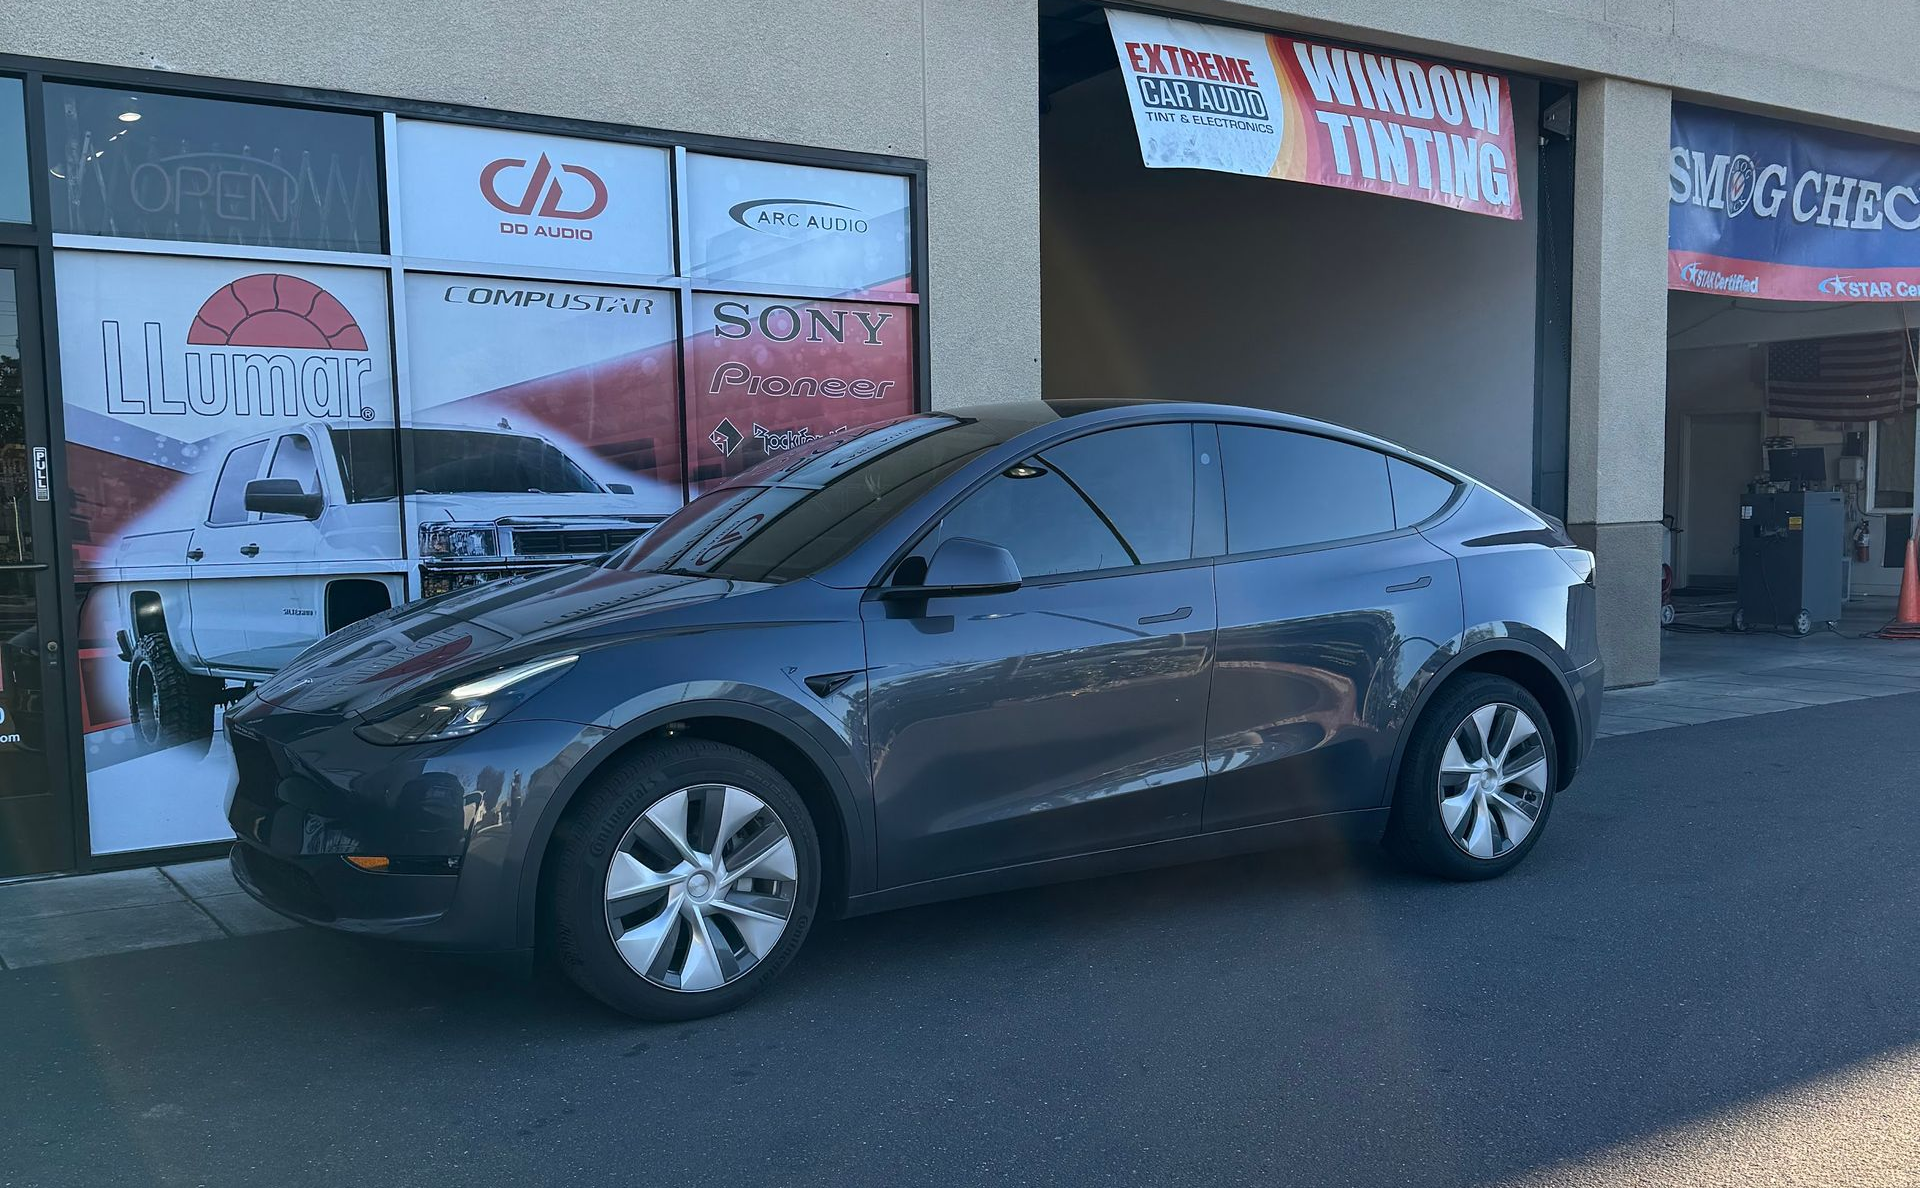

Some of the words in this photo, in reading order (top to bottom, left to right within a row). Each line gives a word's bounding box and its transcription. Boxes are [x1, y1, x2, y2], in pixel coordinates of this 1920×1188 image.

[1124, 42, 1258, 88] EXTREME
[1140, 77, 1195, 109] CAR
[1199, 83, 1267, 119] AUDIO
[1293, 42, 1500, 135] WINDOW
[1145, 111, 1177, 124] TINT
[1180, 116, 1190, 125] &
[1193, 117, 1275, 135] ELECTRONICS
[1316, 110, 1511, 206] TINTING
[130, 163, 288, 223] OPEN
[1669, 146, 1787, 218] SMOG
[1792, 170, 1920, 230] CHEC
[500, 222, 528, 235] DD
[534, 225, 593, 241] AUDIO
[757, 212, 800, 228] ARC
[806, 217, 869, 234] AUDIO
[1696, 268, 1716, 289] STAR
[1715, 272, 1759, 294] Certified
[1849, 281, 1894, 298] STAR
[444, 285, 654, 316] COMPUSTAR
[712, 301, 893, 346] SONY
[708, 362, 895, 400] Pioneer
[36, 452, 47, 488] PULL
